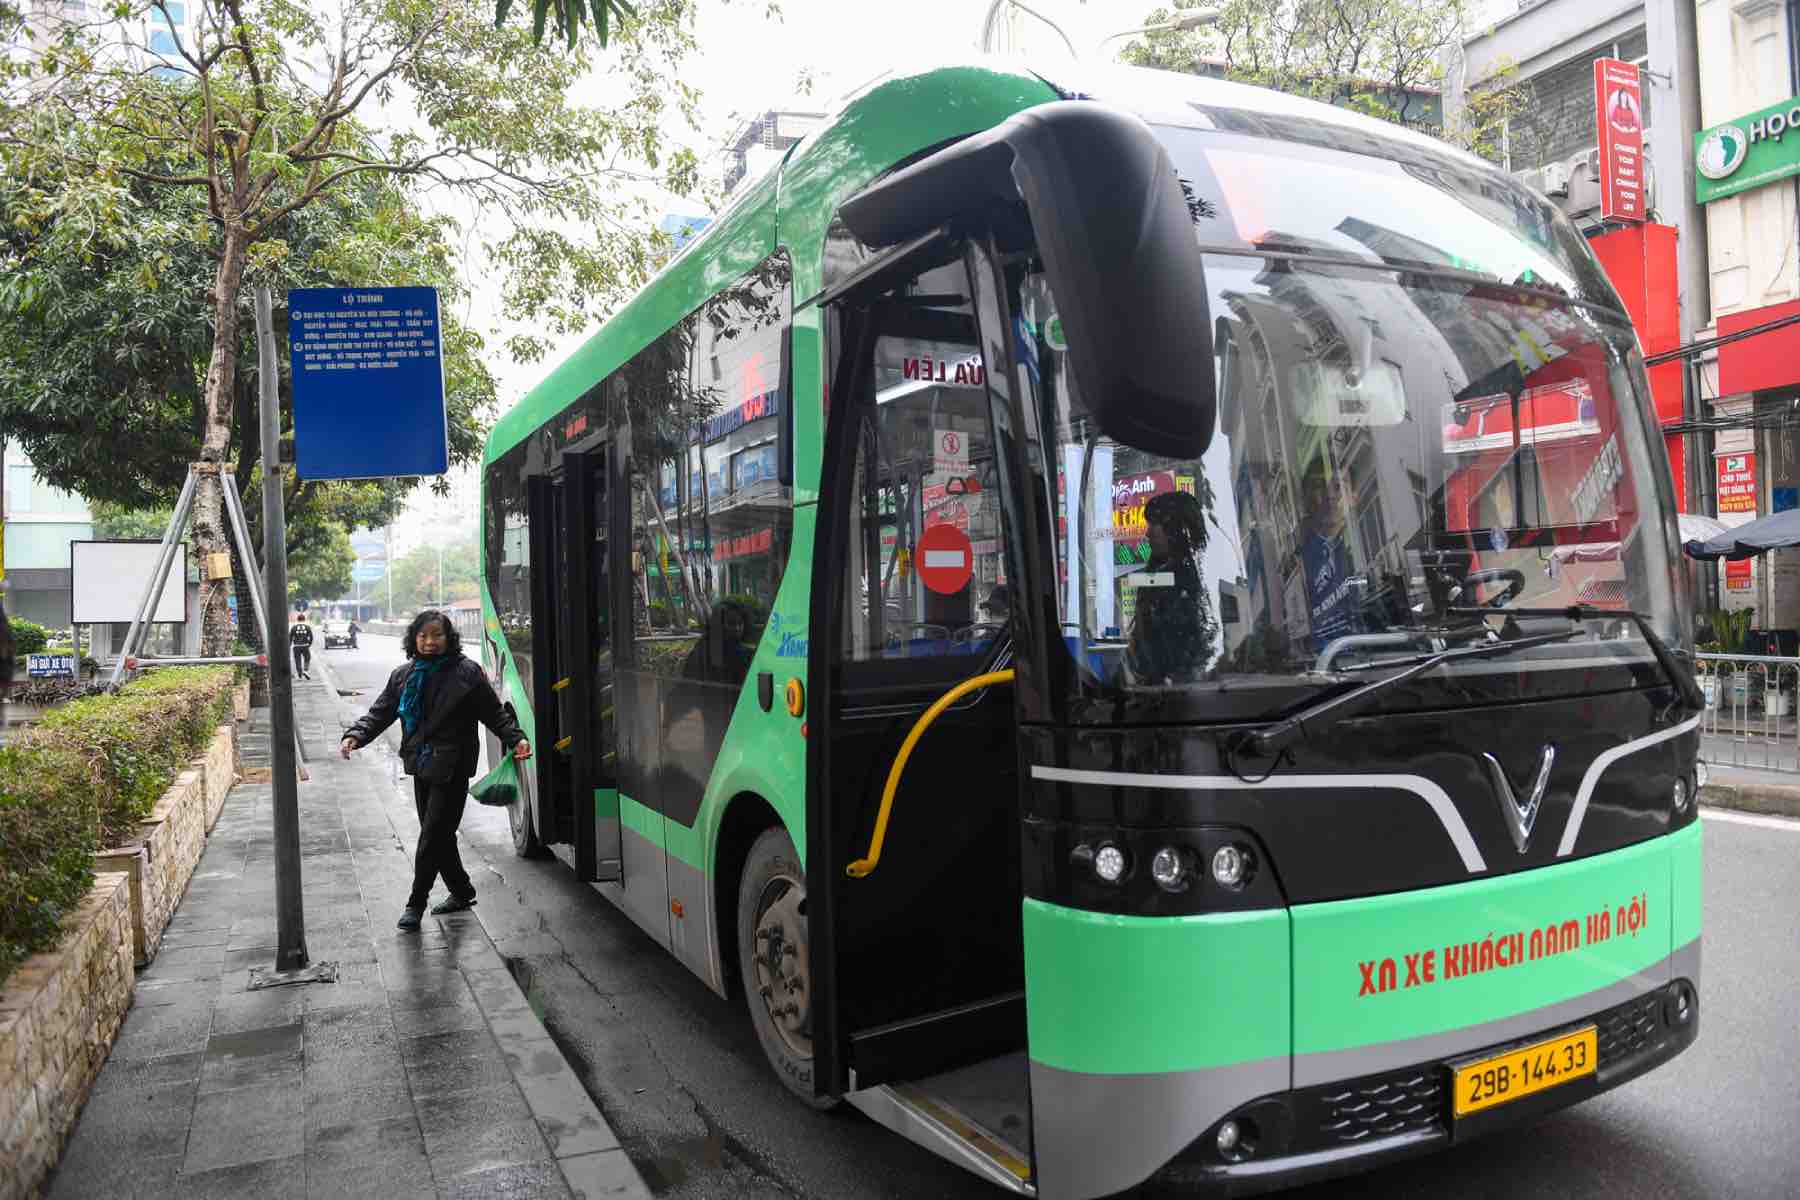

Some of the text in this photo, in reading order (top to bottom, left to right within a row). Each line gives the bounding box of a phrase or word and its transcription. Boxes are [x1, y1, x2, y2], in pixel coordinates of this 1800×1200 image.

[1132, 476, 1155, 496] Anh
[1404, 949, 1436, 988] XE
[1443, 932, 1525, 980] KHÁCH
[1528, 919, 1581, 961] NAM
[1586, 904, 1612, 945] HÀ
[1615, 892, 1647, 938] NỘI
